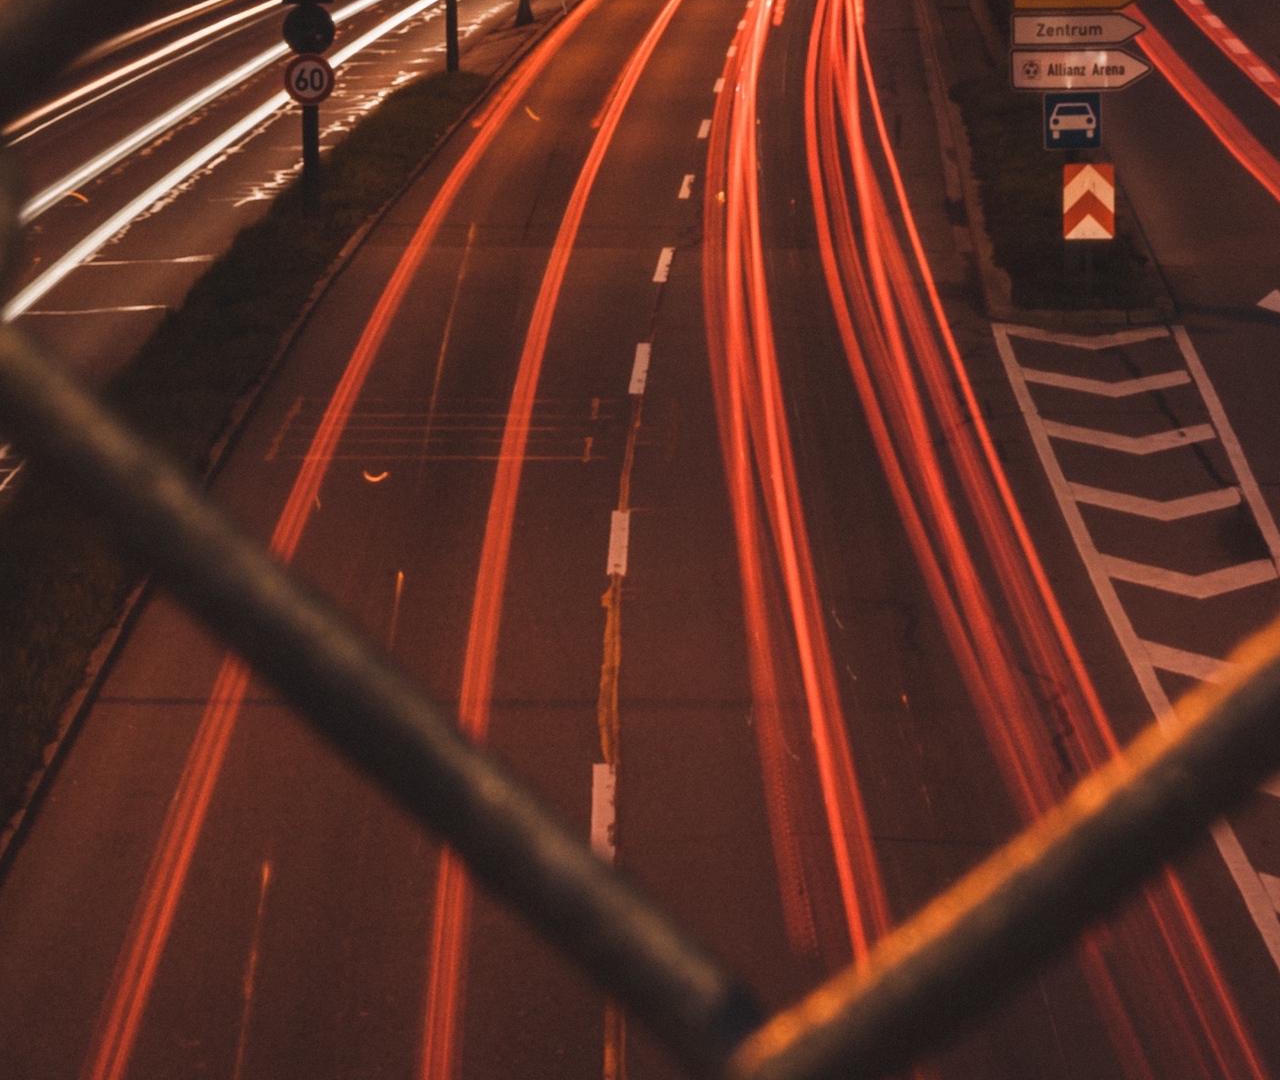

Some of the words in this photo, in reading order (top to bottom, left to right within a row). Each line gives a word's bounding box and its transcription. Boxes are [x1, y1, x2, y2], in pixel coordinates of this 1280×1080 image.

[1036, 24, 1103, 37] Zentrum
[1047, 63, 1086, 77] Allianz
[1092, 63, 1125, 76] Arena
[295, 68, 324, 91] 60
